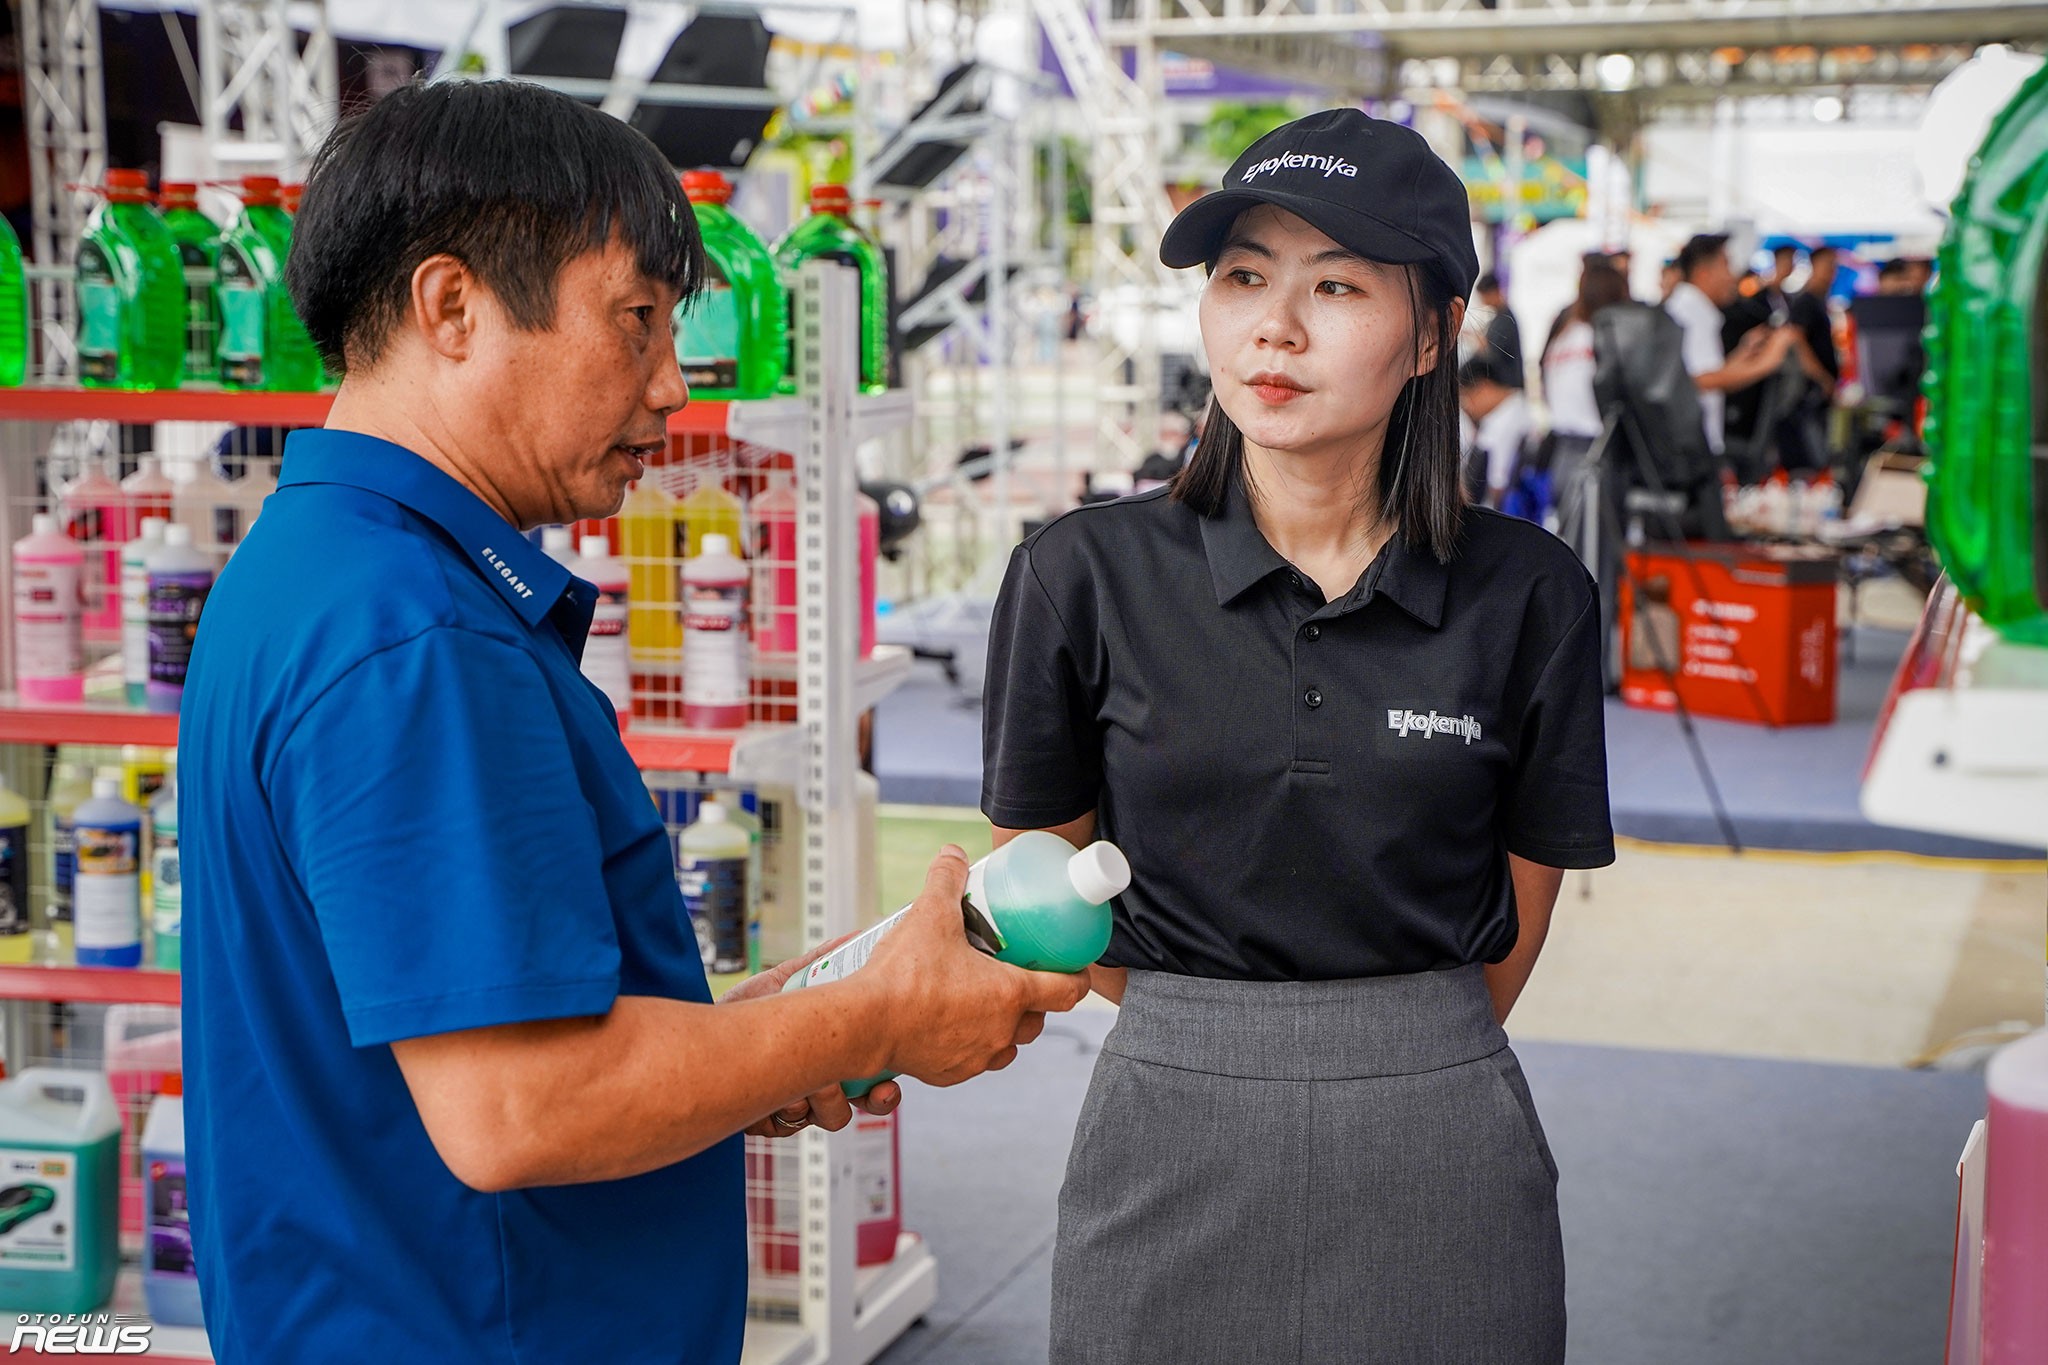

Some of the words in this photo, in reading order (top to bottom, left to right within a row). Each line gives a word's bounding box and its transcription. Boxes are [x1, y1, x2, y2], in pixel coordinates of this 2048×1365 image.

[1241, 150, 1359, 184] Ekokemika
[481, 547, 533, 599] ELEGANT
[1387, 709, 1482, 746] Ekokemika
